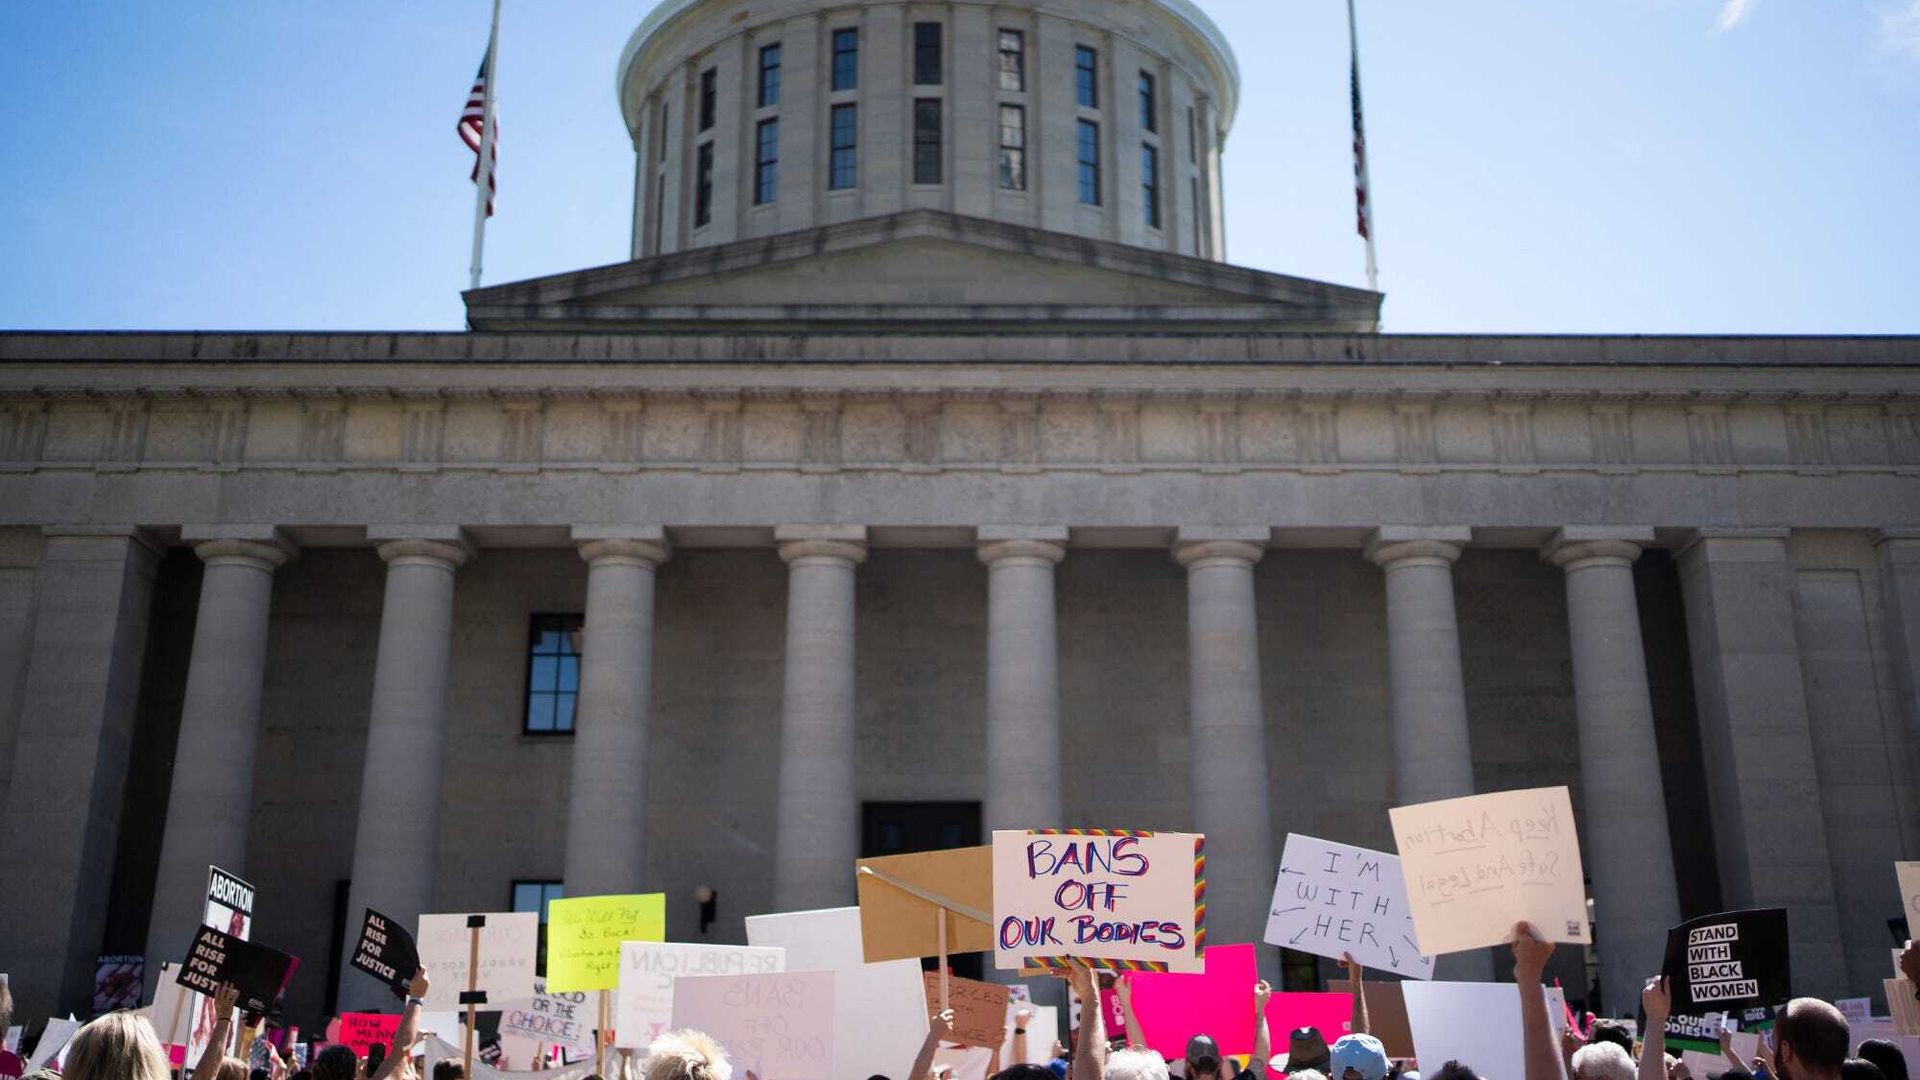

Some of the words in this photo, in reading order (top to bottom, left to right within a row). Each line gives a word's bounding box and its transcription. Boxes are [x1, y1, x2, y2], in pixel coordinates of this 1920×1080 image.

[1027, 837, 1150, 879] BANS
[209, 872, 254, 911] ABORTION
[1054, 879, 1130, 912] OFF
[1298, 881, 1390, 916] WITH
[368, 914, 385, 931] ALL
[1314, 914, 1378, 947] HER
[201, 931, 224, 949] ALL
[365, 927, 387, 945] RISE
[999, 915, 1063, 951] OUR
[1067, 914, 1186, 950] BODIES
[1691, 925, 1737, 943] STAND
[195, 944, 226, 964] RISE
[361, 939, 382, 958] FOR
[1690, 946, 1728, 962] WITH
[97, 954, 145, 964] ABORTION
[190, 957, 217, 976] FOR
[356, 952, 397, 980] JUSTICE
[184, 971, 218, 991] JUST
[1691, 964, 1740, 980] BLACK
[1693, 981, 1757, 999] WOMEN
[555, 1002, 577, 1019] THE
[510, 1010, 582, 1038] CHOICE!
